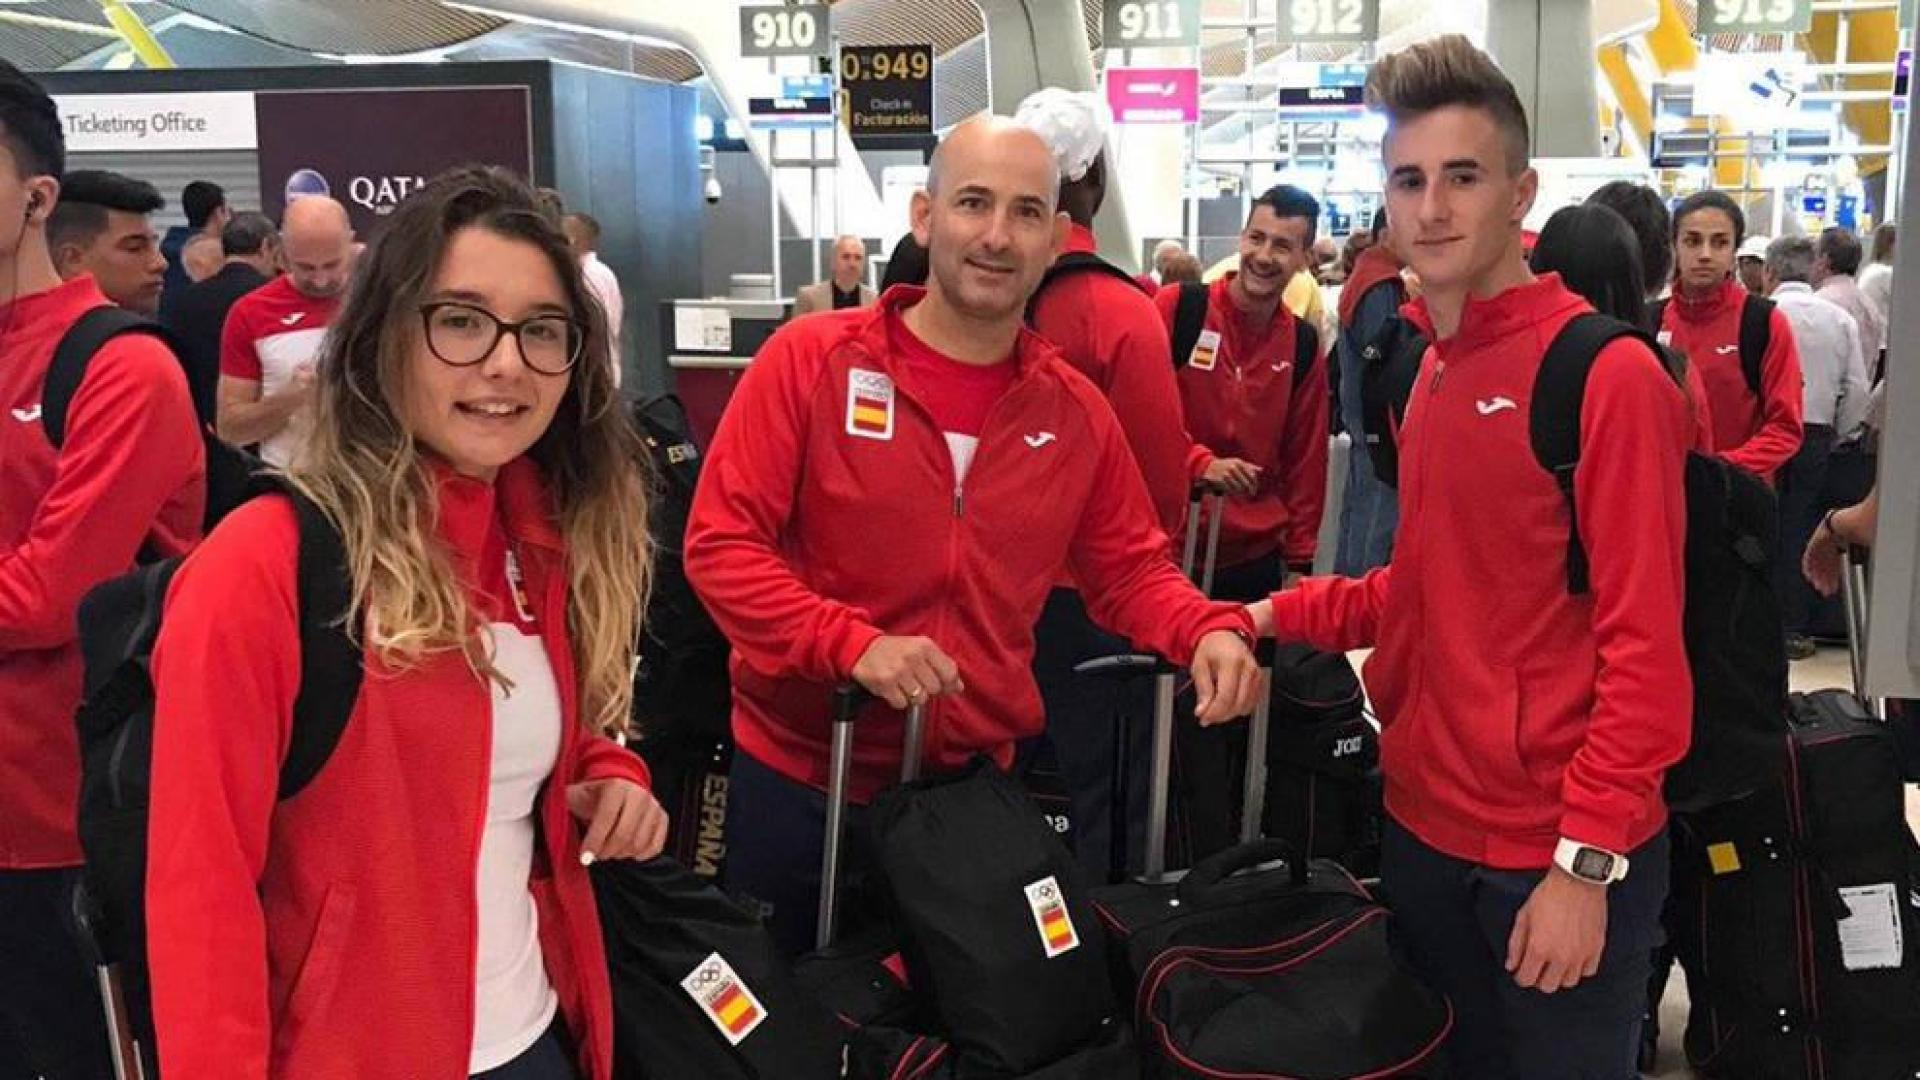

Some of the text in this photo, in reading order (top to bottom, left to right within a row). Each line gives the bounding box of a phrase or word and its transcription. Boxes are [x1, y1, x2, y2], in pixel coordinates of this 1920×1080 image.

[753, 12, 816, 48] 910
[1119, 3, 1181, 38] 911
[1291, 0, 1362, 33] 912
[873, 51, 929, 80] 949
[66, 111, 208, 138] Ticketing Office
[693, 773, 728, 876] ESPAÑA
